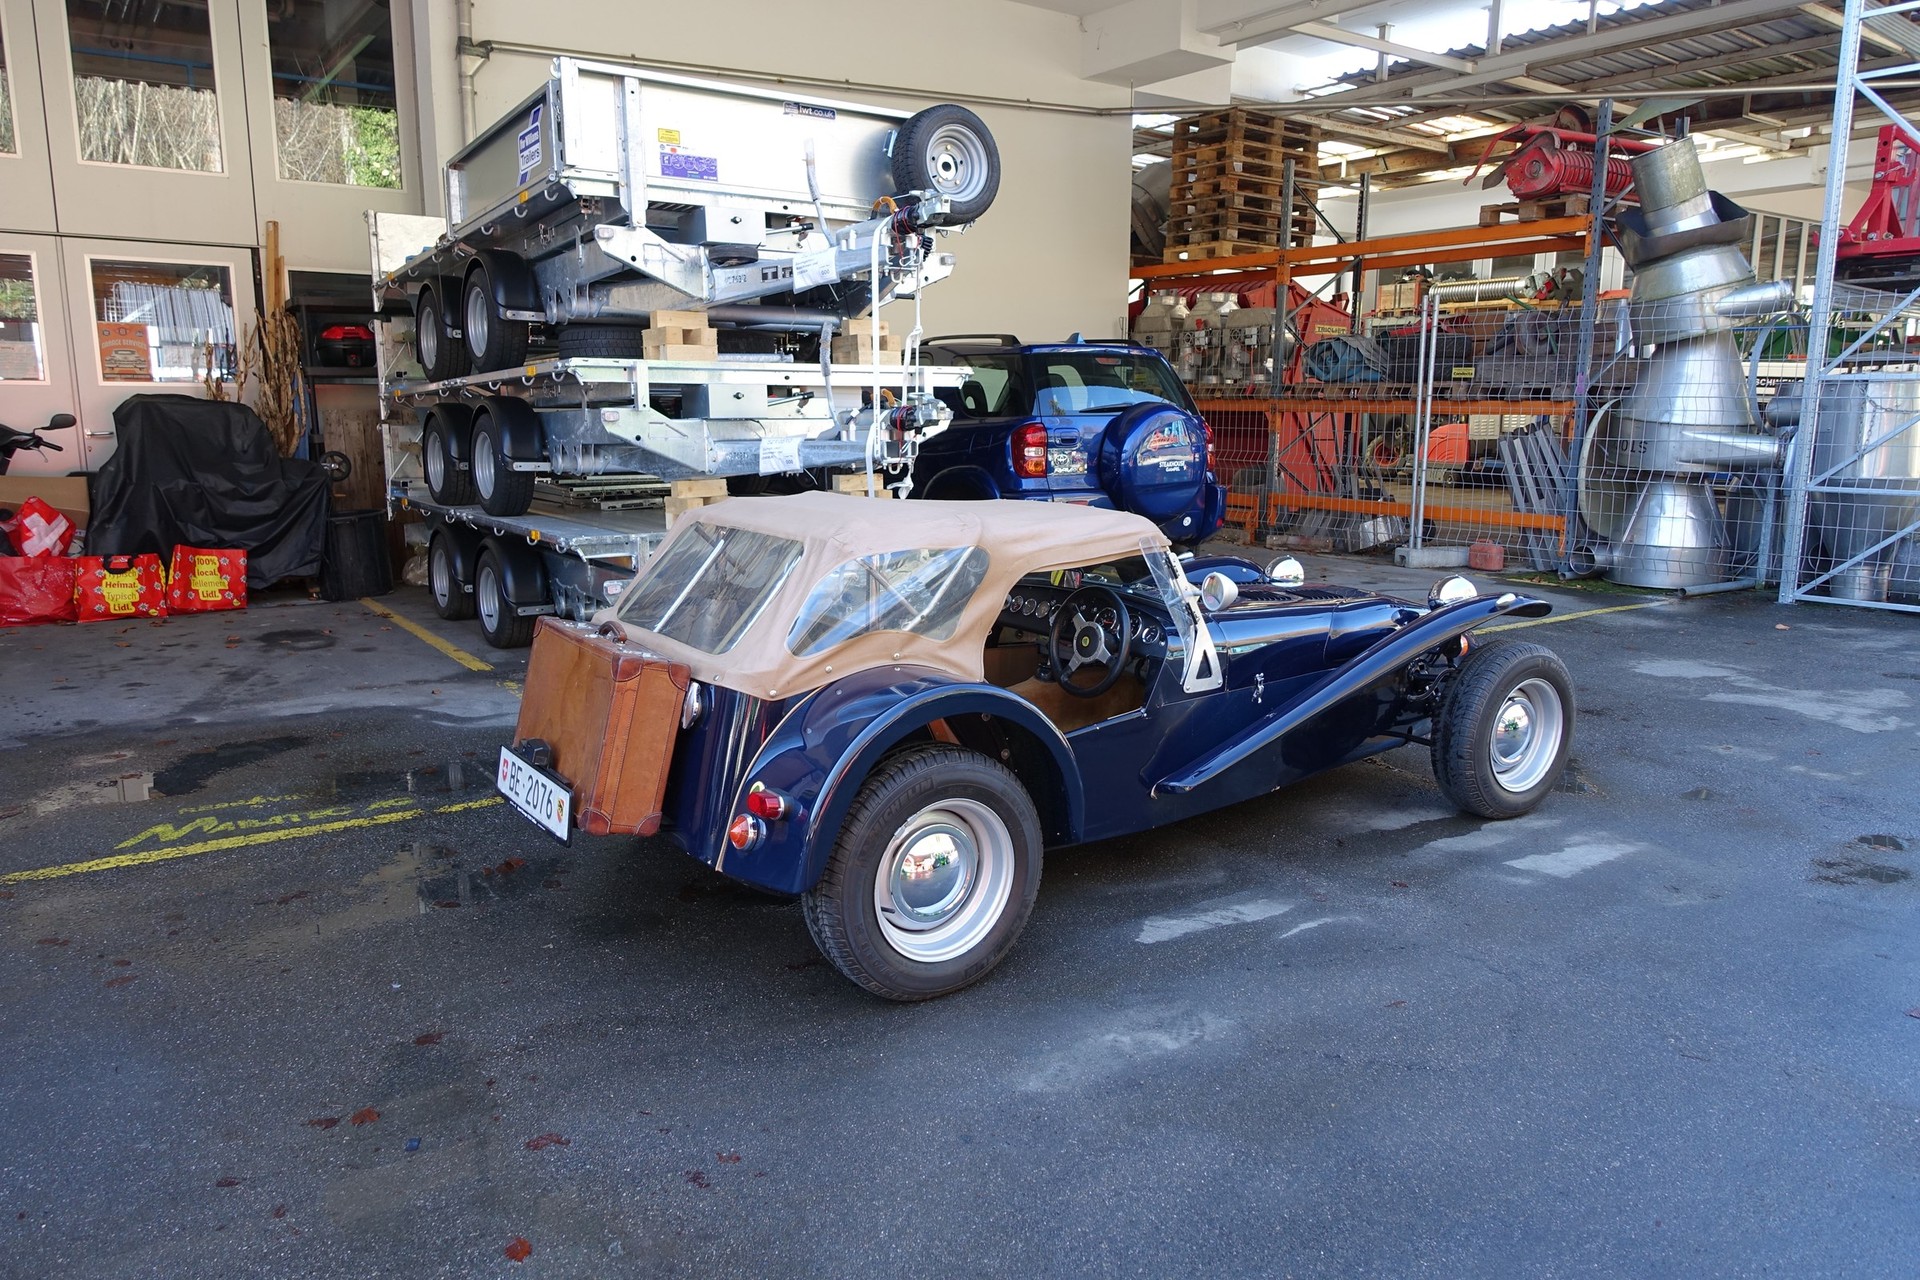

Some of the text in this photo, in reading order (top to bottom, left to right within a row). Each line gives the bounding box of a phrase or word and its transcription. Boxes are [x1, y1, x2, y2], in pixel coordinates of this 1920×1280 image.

[521, 147, 539, 167] Trailers
[122, 339, 147, 351] SERVICES
[197, 557, 217, 565] 100%
[107, 592, 136, 601] Typisch
[202, 590, 219, 598] Lidl.
[113, 603, 133, 611] Lidl.
